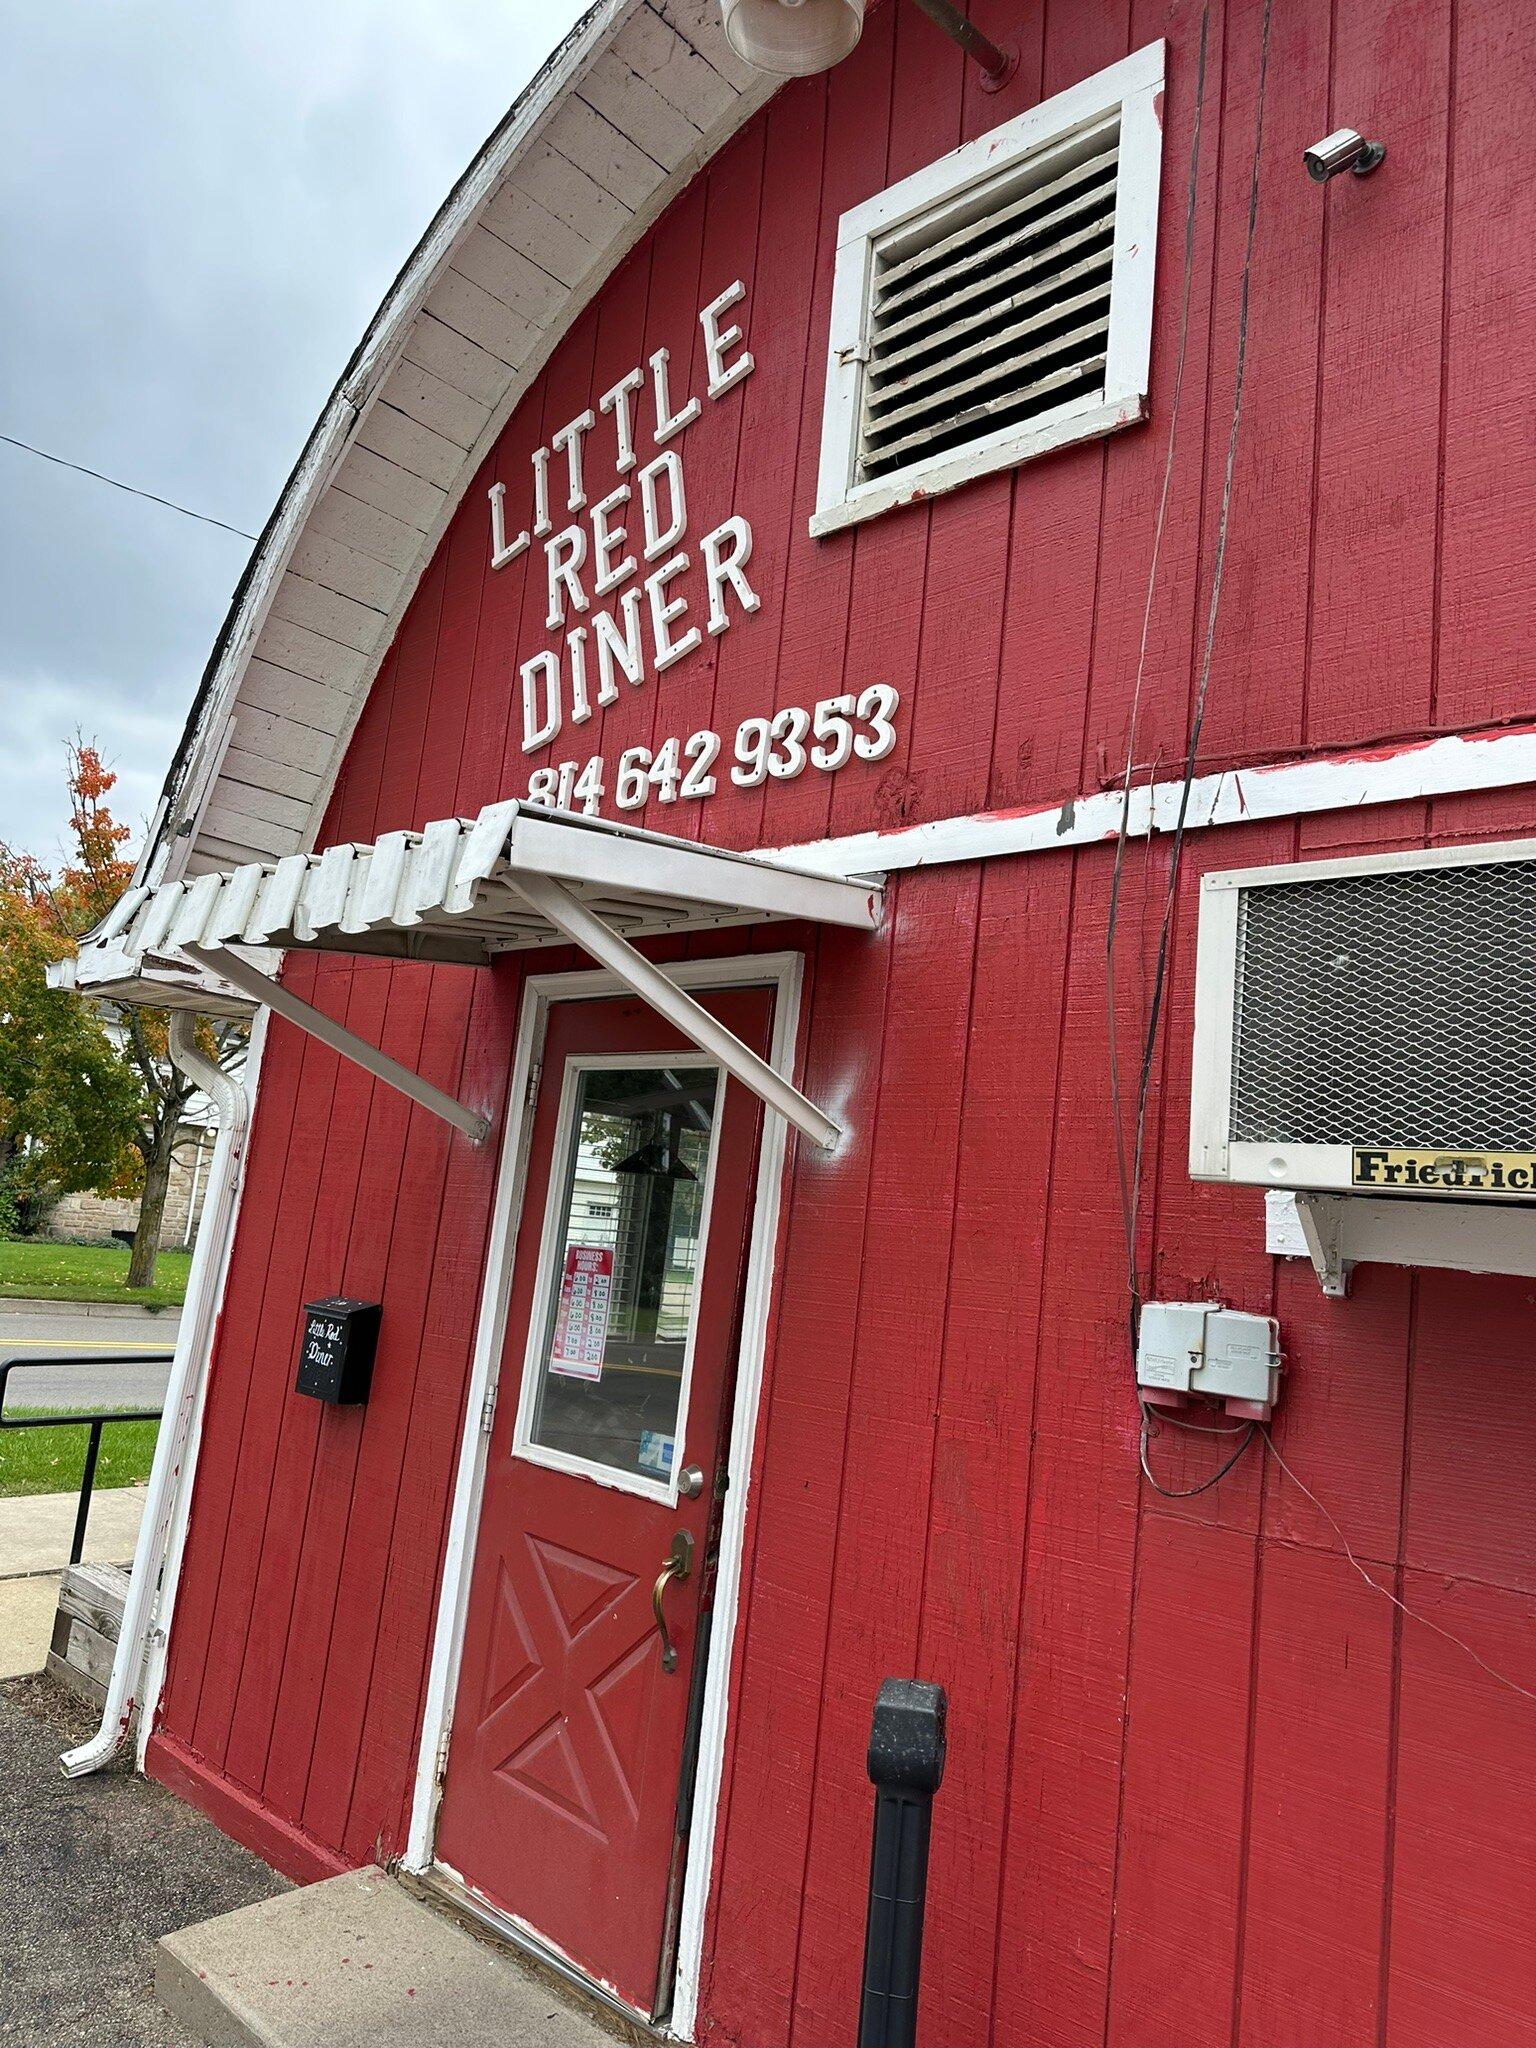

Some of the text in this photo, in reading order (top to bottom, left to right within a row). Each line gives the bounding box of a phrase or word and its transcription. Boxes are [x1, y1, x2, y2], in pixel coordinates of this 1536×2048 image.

[488, 279, 755, 571] LITTLE
[544, 450, 687, 630] RED
[519, 515, 761, 754] DINER
[527, 683, 900, 816] 814 642 9353
[308, 1319, 340, 1342] Little Red
[308, 1341, 333, 1366] Diner
